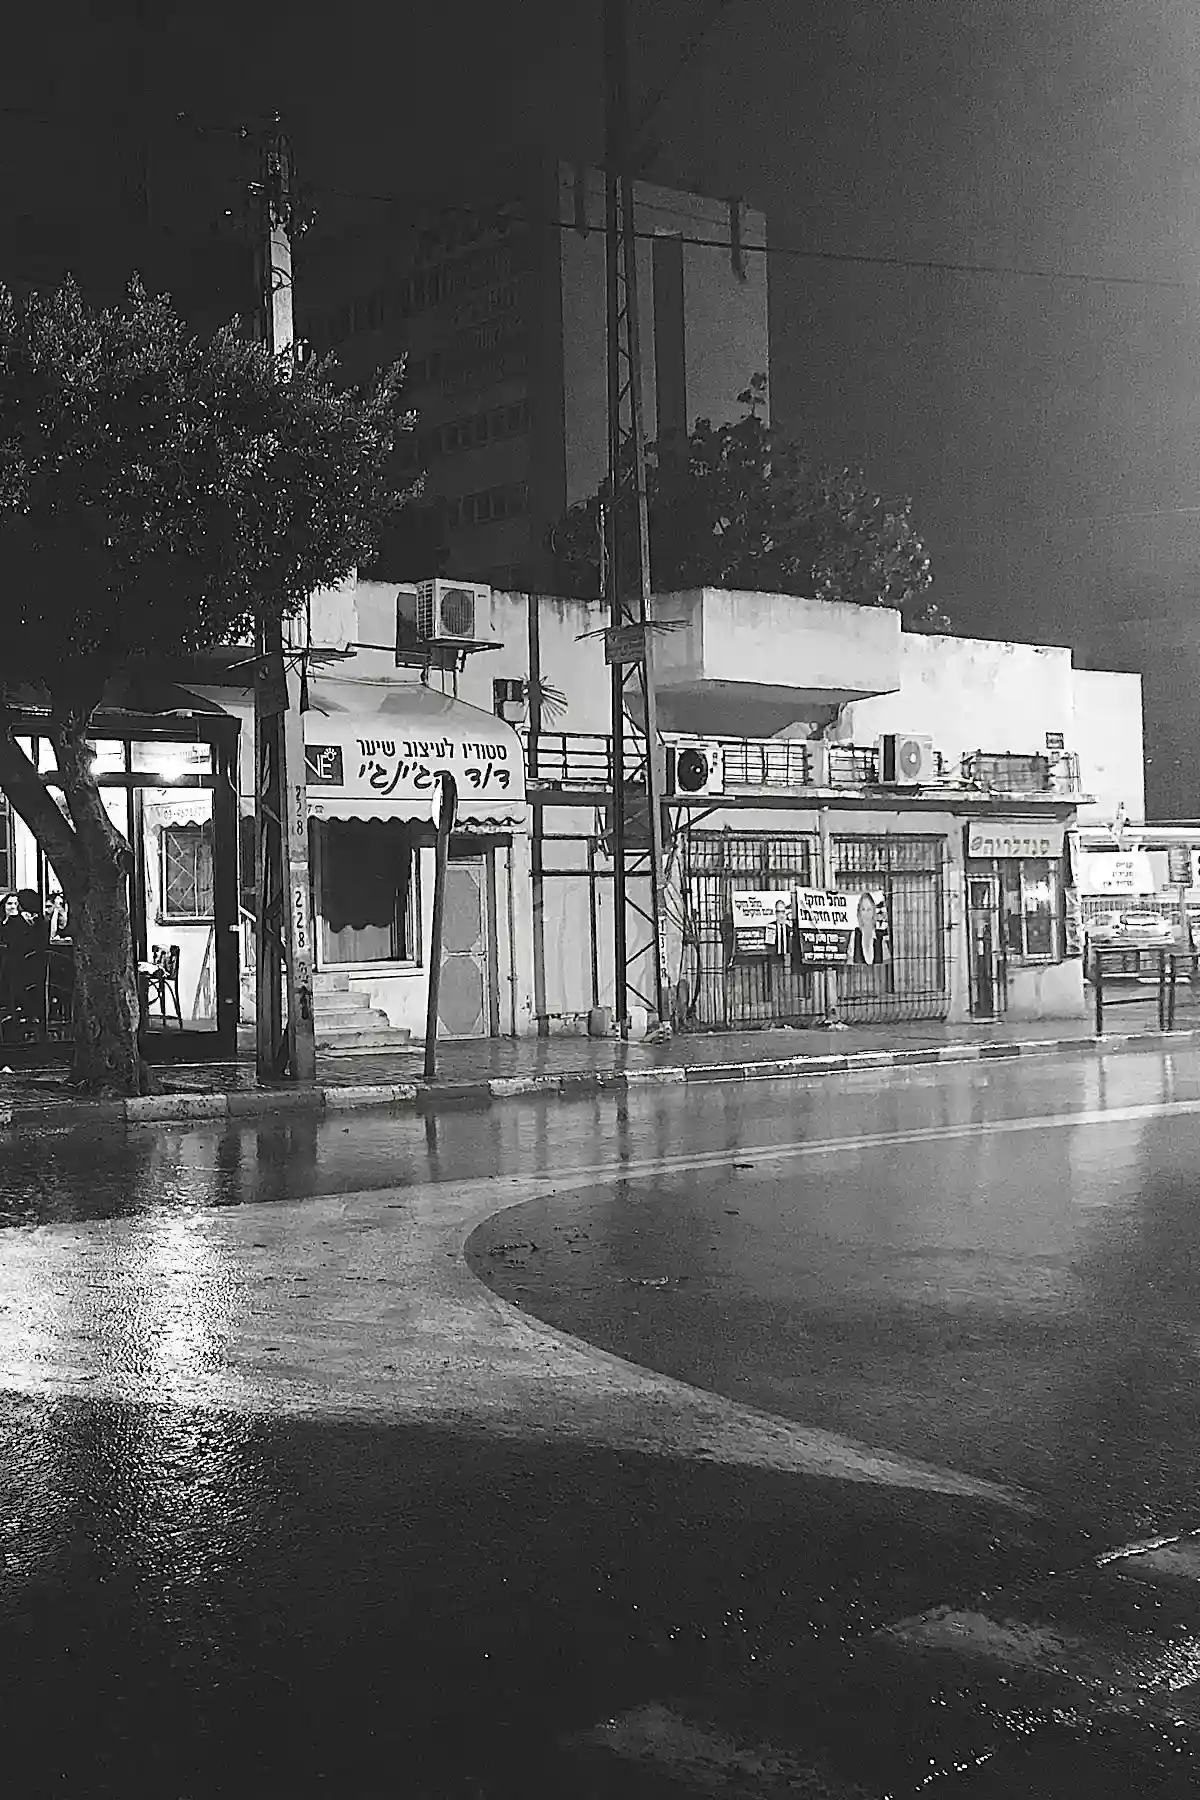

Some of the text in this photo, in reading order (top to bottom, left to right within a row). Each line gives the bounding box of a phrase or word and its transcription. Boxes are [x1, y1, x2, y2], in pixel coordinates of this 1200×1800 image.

[356, 737, 507, 760] סטודיו לעיצוב שיער
[983, 835, 1051, 856] סנדלריה
[295, 890, 305, 948] 228
